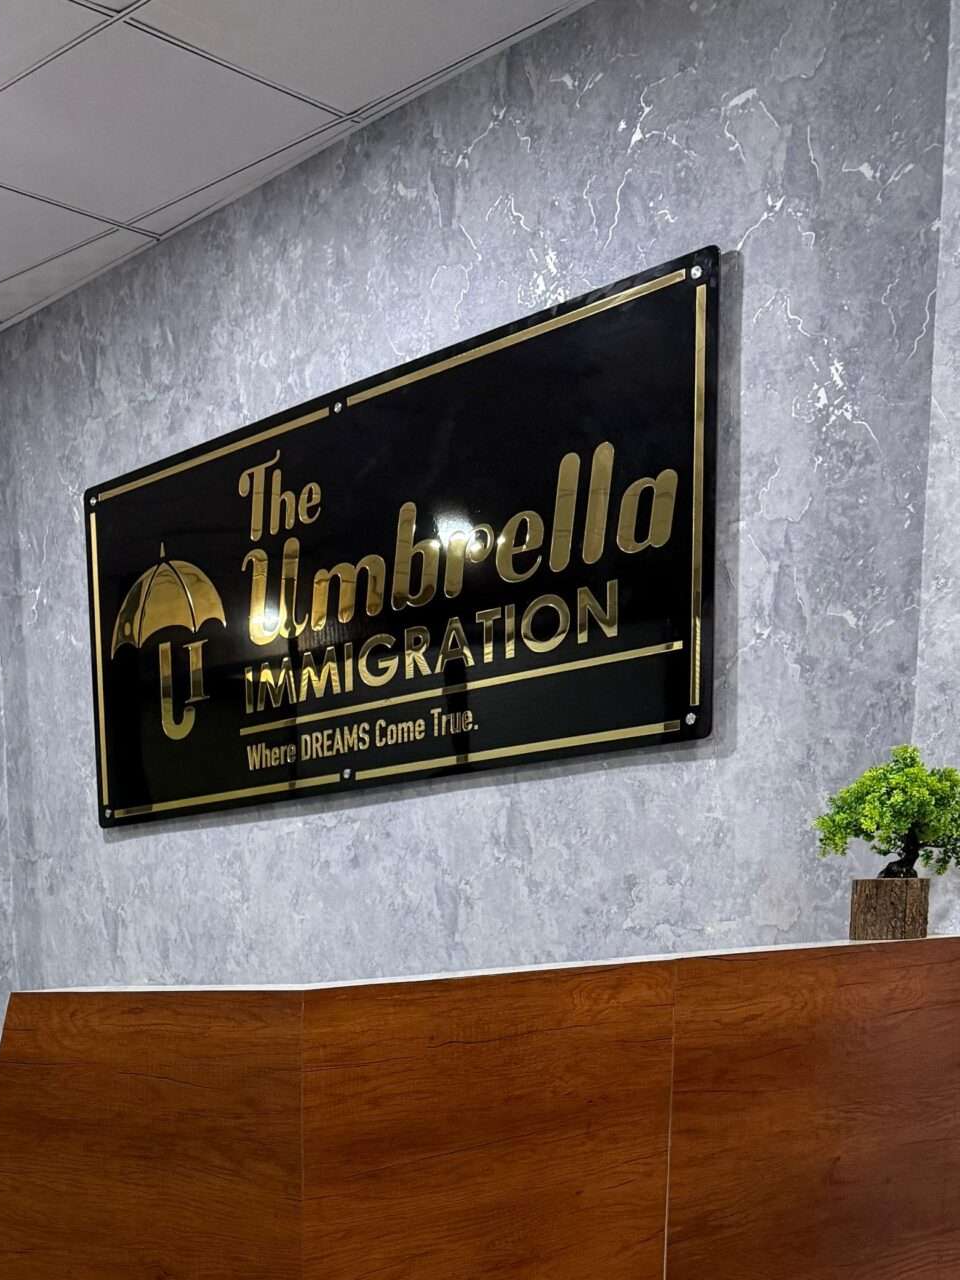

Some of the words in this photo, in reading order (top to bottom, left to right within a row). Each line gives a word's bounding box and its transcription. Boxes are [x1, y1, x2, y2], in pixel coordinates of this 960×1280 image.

[238, 448, 322, 541] The
[241, 441, 678, 647] Umbrella
[244, 579, 619, 714] IMMIGRATION
[247, 742, 297, 771] Where
[301, 722, 370, 761] DREAMS
[375, 717, 426, 748] Come
[430, 707, 479, 737] True.
